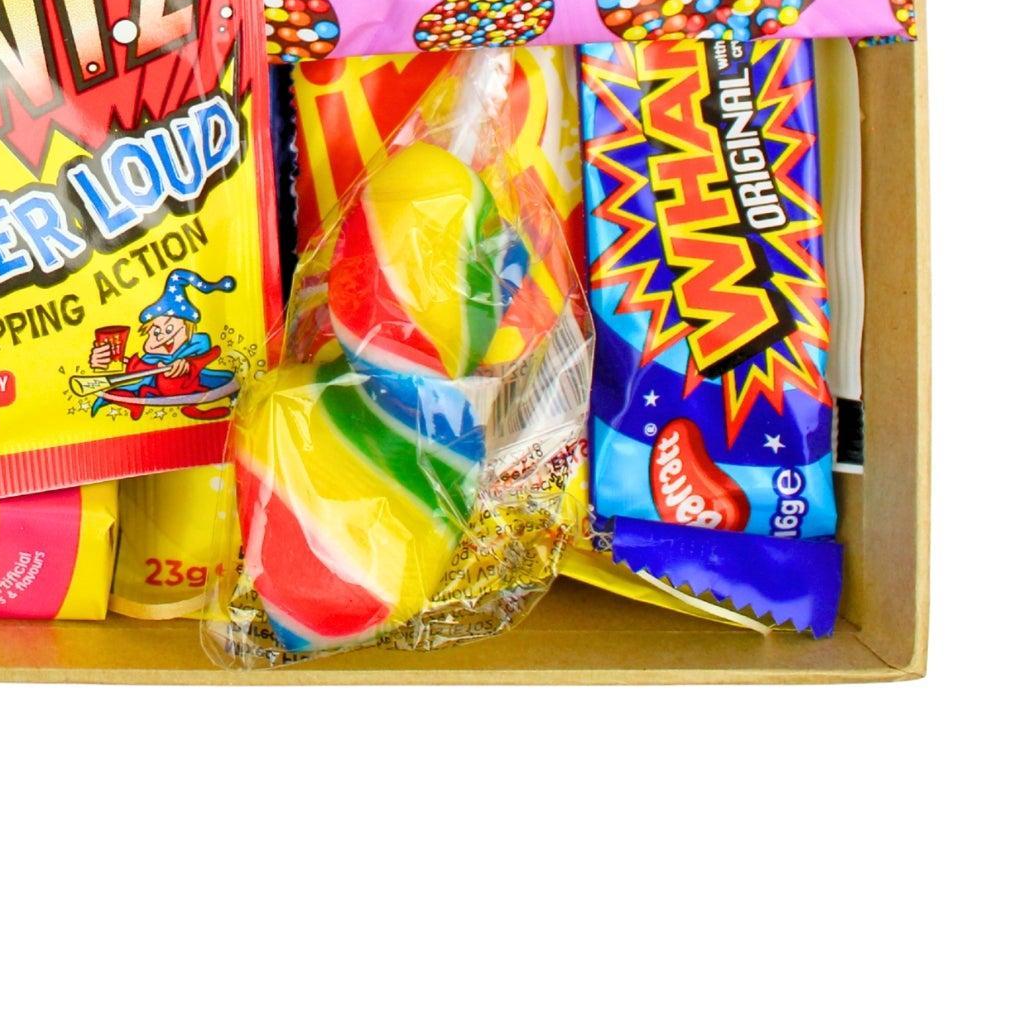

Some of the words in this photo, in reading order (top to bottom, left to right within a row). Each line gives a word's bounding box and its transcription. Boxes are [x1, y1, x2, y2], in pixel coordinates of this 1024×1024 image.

[69, 95, 241, 241] LOUD
[719, 67, 788, 230] ORIGINAL
[96, 216, 210, 306] ACTION
[15, 551, 45, 591] flavours
[144, 558, 208, 588] 23g
